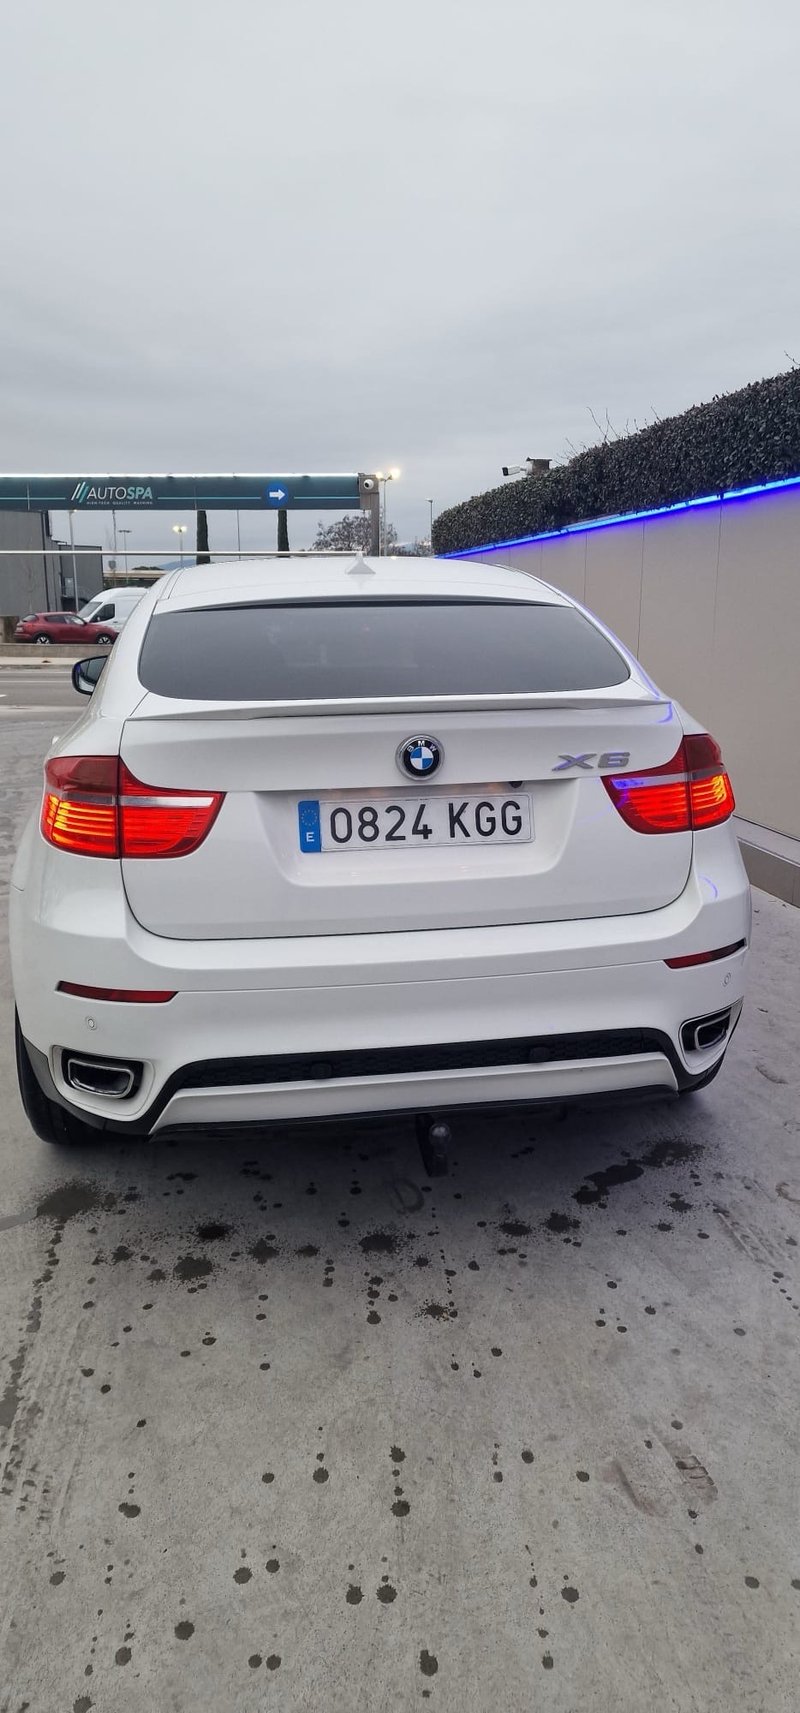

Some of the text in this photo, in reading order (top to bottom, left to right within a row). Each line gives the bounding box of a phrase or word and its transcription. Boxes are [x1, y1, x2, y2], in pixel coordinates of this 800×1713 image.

[86, 486, 153, 500] AUTOSPA
[406, 740, 437, 753] BMW
[551, 751, 631, 771] X6
[329, 800, 524, 844] 0824 KGG
[305, 831, 315, 843] E
